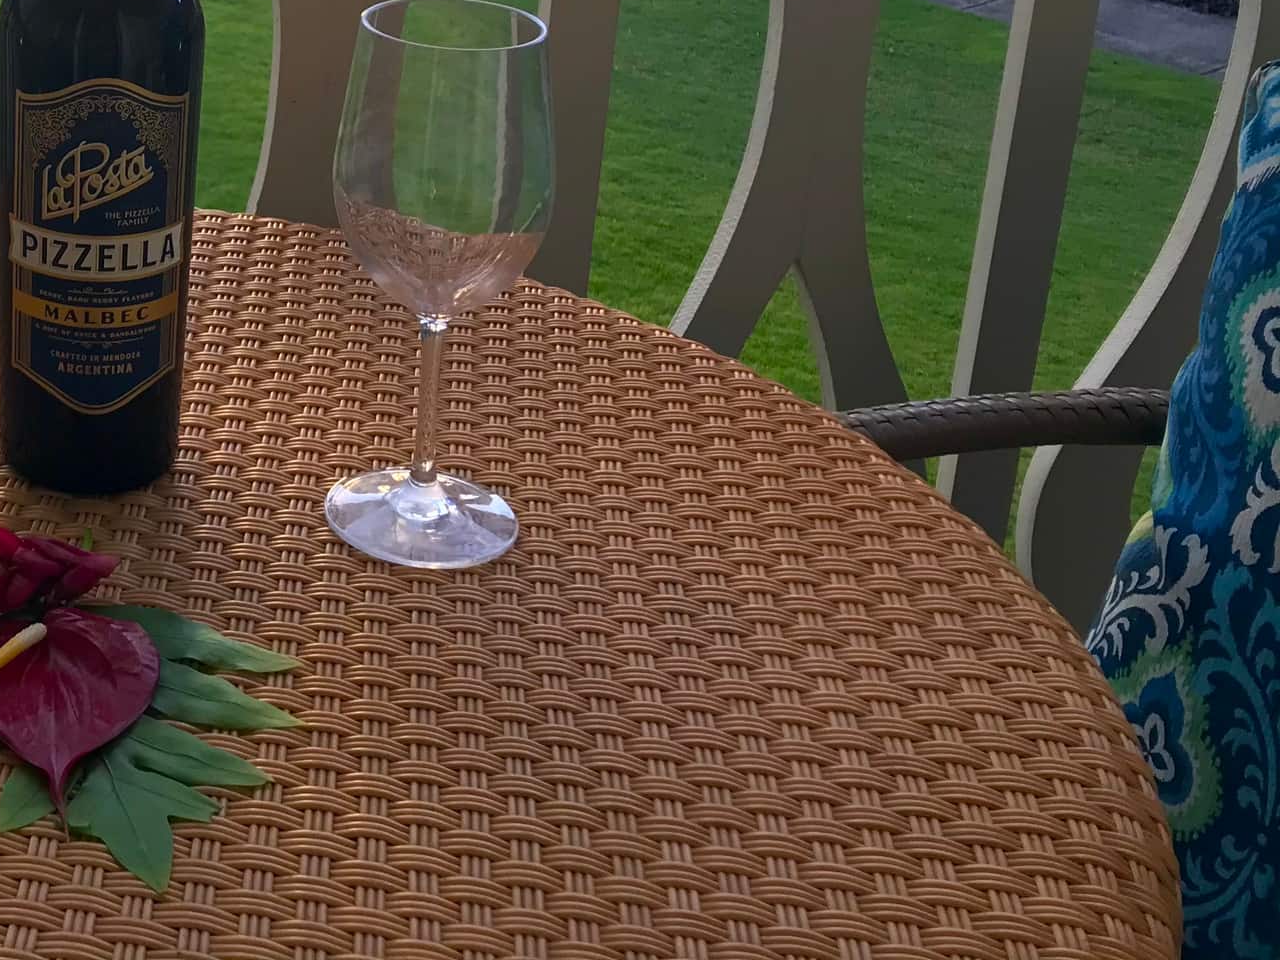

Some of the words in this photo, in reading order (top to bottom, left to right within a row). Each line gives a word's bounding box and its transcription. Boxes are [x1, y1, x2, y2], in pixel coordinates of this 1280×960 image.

[56, 140, 153, 223] Posta
[104, 211, 121, 220] THE
[124, 206, 161, 219] PIZZELLA
[116, 216, 149, 227] FAMILY
[22, 230, 175, 272] PIZZELLA
[44, 304, 150, 325] MALBEC
[49, 349, 87, 361] CRAFTED
[89, 354, 100, 362] IN
[57, 361, 134, 375] ARGENTINA
